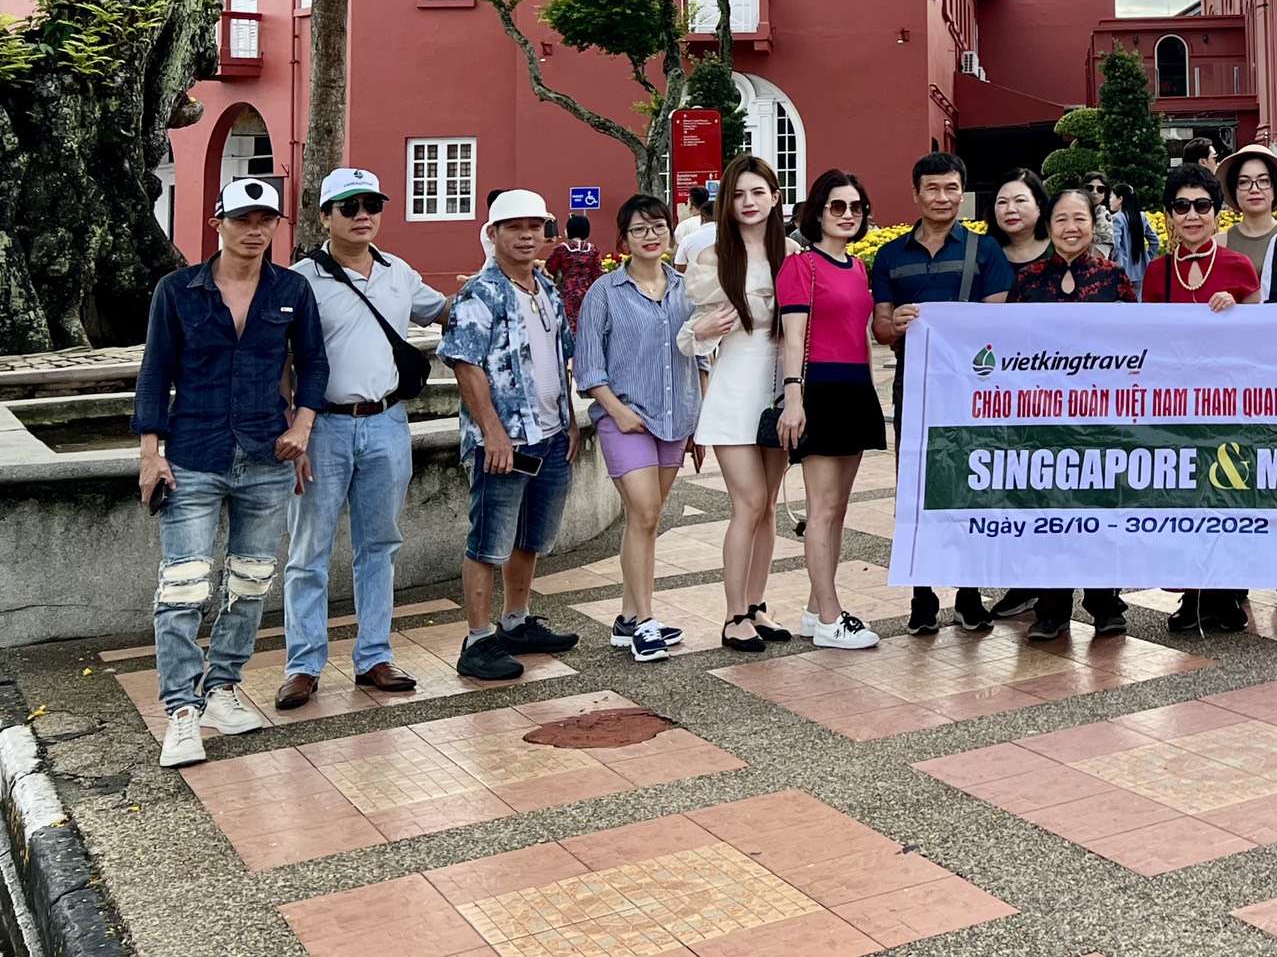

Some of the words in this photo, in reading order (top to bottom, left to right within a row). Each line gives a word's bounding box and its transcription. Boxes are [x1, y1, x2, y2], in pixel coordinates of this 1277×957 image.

[1000, 349, 1148, 376] vietkingtravel
[971, 386, 1012, 419] CHÀO
[1016, 385, 1063, 418] MỪNG
[1068, 384, 1110, 417] ĐOÀN
[1115, 384, 1148, 423] VIỆT
[1153, 387, 1188, 417] NAM
[1193, 387, 1238, 417] THAM
[967, 448, 1197, 491] SINGGAPORE
[1209, 443, 1251, 491] &
[968, 515, 1027, 536] Ngày
[1033, 516, 1101, 534] 26/10
[1125, 516, 1270, 534] 30/10/2022
